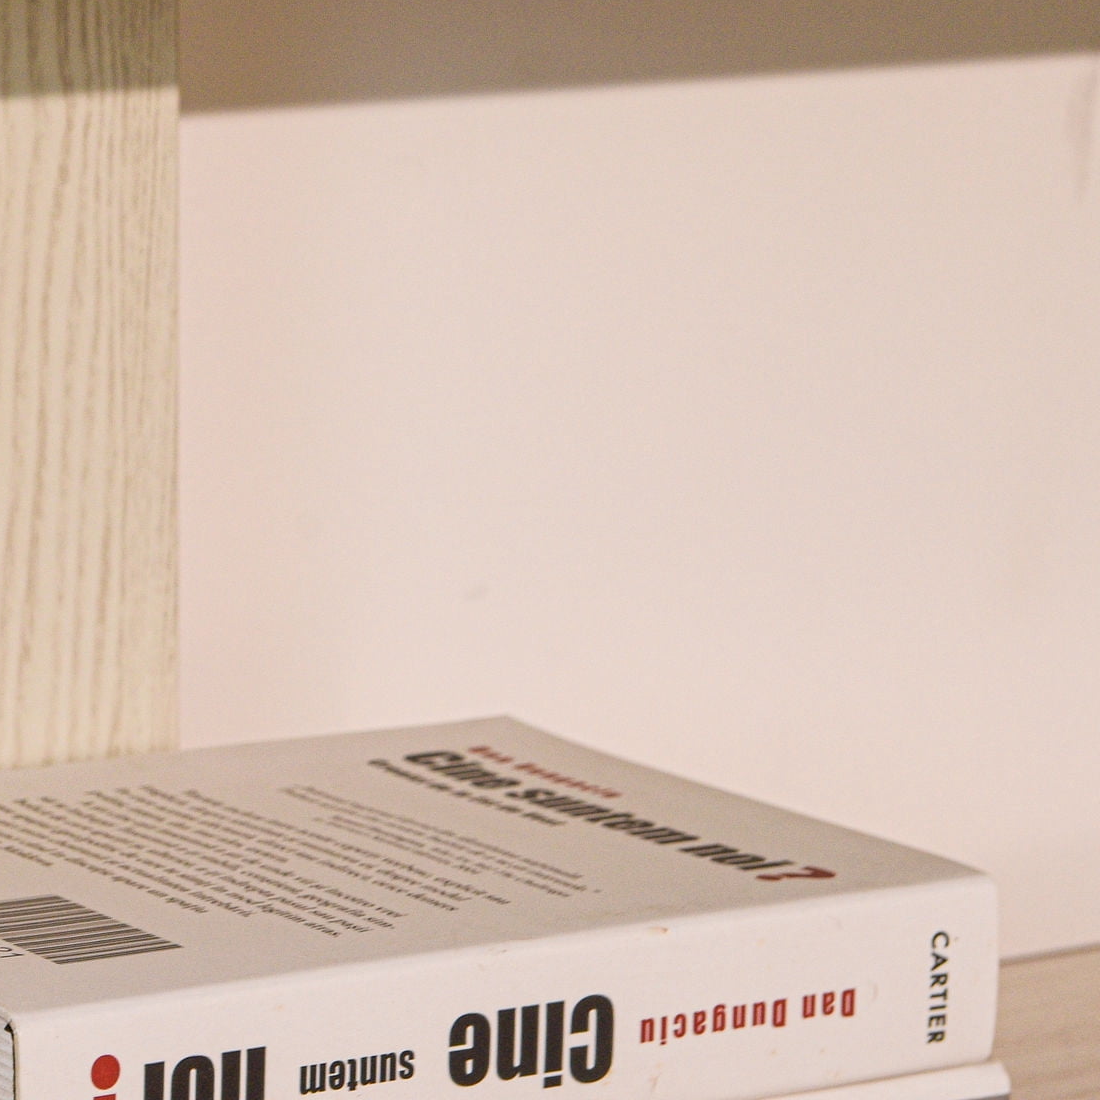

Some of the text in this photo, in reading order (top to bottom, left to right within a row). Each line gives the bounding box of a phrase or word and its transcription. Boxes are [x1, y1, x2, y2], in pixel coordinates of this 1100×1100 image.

[404, 750, 521, 790] Cine
[507, 786, 701, 845] suntem
[640, 988, 856, 1045] Dan Dungaciu
[924, 930, 950, 1044] CARTIER
[300, 1049, 416, 1095] suntem
[448, 994, 615, 1088] Cine
